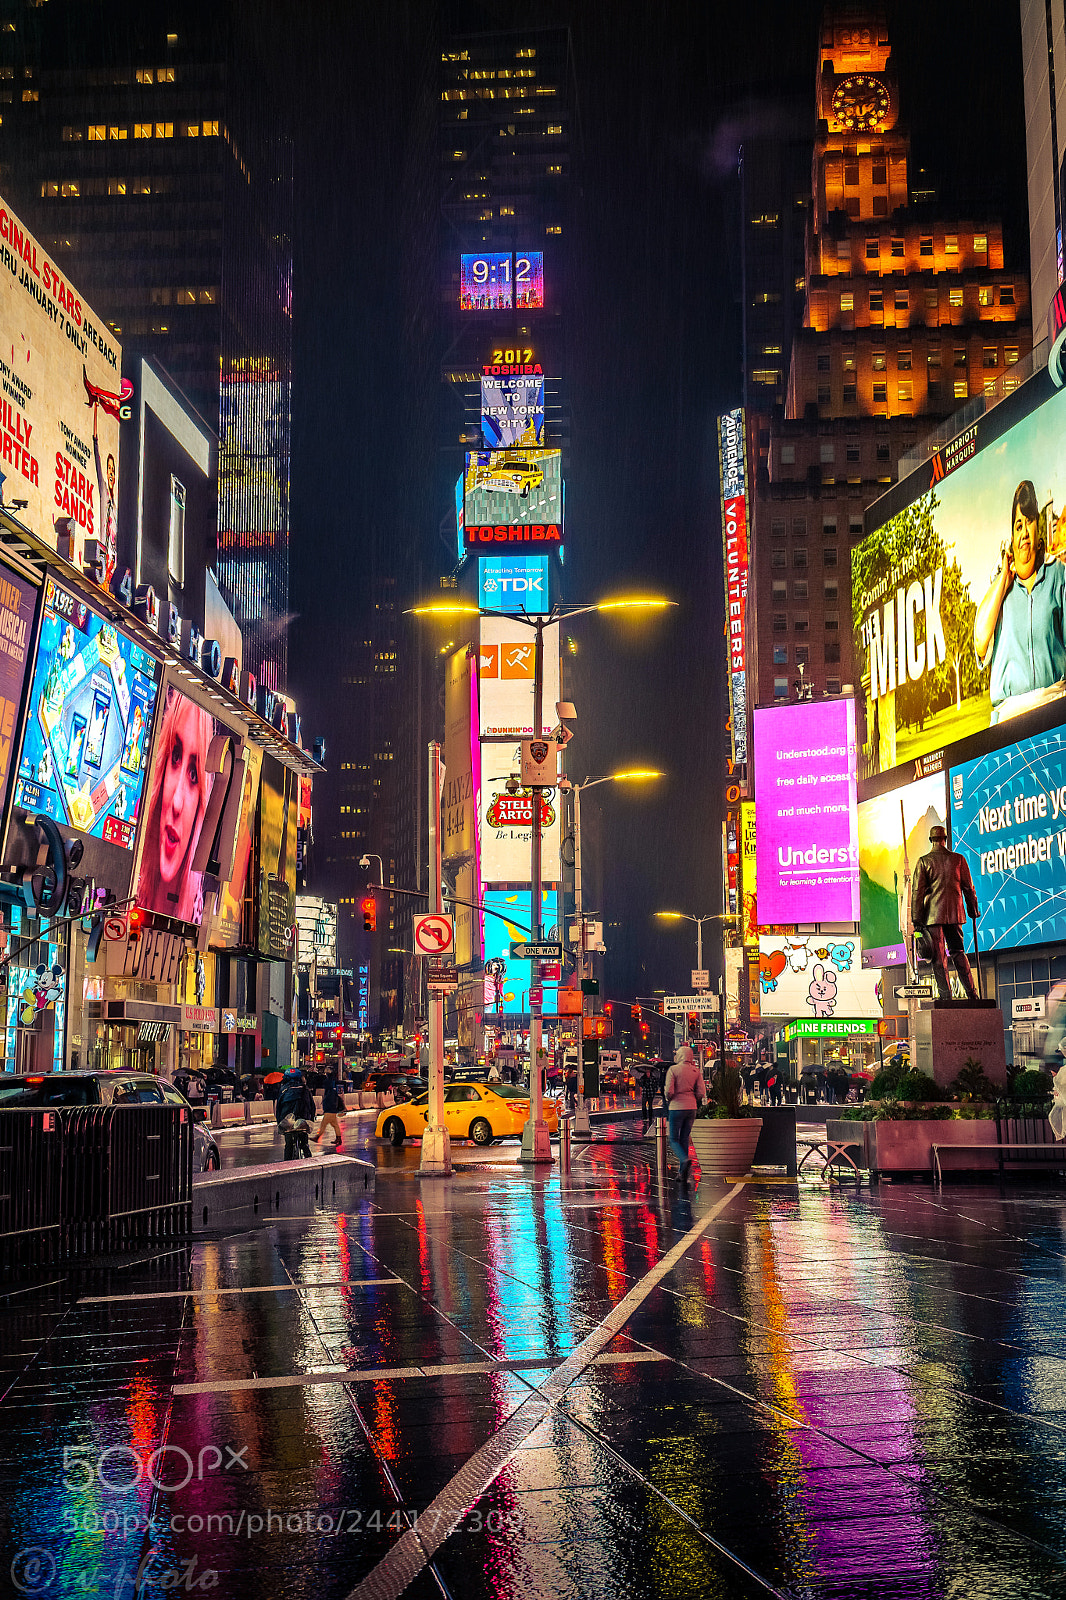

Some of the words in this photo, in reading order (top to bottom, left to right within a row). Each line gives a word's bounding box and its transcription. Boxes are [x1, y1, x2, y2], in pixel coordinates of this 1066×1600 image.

[473, 258, 531, 283] 9:12
[19, 268, 58, 323] JANUARY
[59, 312, 65, 329] 7
[65, 322, 88, 358] ONLY!
[42, 261, 82, 326] STARS
[82, 318, 98, 347] ARE
[98, 336, 117, 370] BACK
[493, 349, 533, 364] 2017
[482, 364, 543, 375] TOSHIBA
[11, 373, 32, 399] AWARD
[484, 379, 542, 389] WELCOME
[505, 393, 521, 402] TO
[481, 407, 507, 416] NEW
[512, 405, 544, 414] YORK
[499, 419, 526, 428] CITY
[60, 421, 74, 442] TONY
[73, 437, 91, 459] AWARD
[945, 425, 978, 458] MARRIOTT
[725, 415, 739, 487] AUDIENCE
[946, 442, 975, 472] MARQUIS
[55, 451, 94, 508] STARK
[54, 479, 94, 535] SANDS
[465, 524, 560, 542] TOSHIBA
[497, 577, 544, 592] TDK
[724, 502, 743, 670] VOLUNTEERS
[860, 570, 889, 611] Comin'
[891, 565, 900, 585] in
[860, 613, 878, 649] THE
[869, 566, 946, 701] MICK
[492, 726, 523, 734] DUNKIN'
[776, 746, 846, 760] Understood.org
[776, 777, 795, 787] free
[797, 774, 818, 786] daily
[820, 772, 851, 783] access
[499, 800, 533, 810] STELL
[777, 806, 794, 817] and
[796, 804, 821, 815] much
[823, 804, 850, 813] more.
[979, 799, 1013, 835] Next
[1013, 793, 1048, 824] time
[446, 806, 465, 837] 4:44
[496, 830, 508, 840] Be
[778, 843, 859, 867] Underst
[981, 834, 1054, 876] remember
[779, 878, 789, 887] for
[790, 877, 816, 886] learning
[823, 875, 853, 884] attention
[525, 947, 540, 955] ONE
[193, 1007, 204, 1020] POLO
[820, 1023, 867, 1033] FRIENDS
